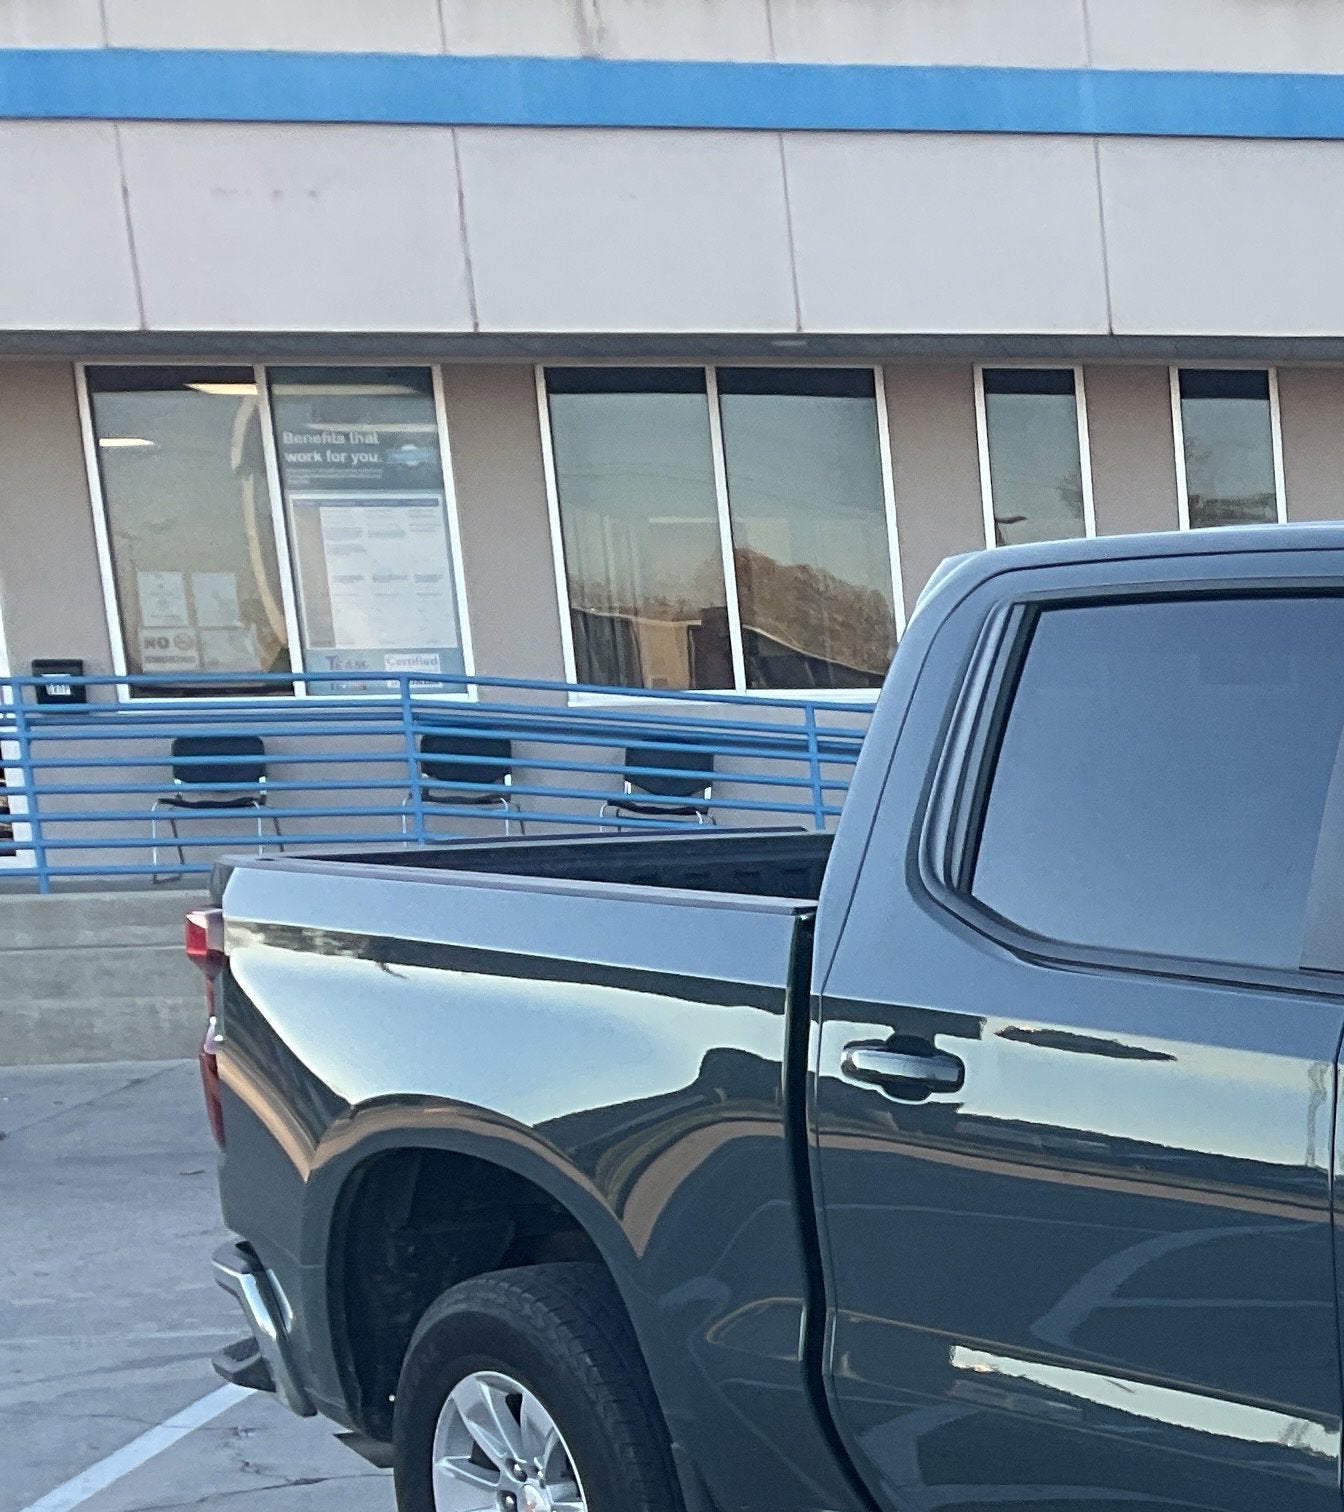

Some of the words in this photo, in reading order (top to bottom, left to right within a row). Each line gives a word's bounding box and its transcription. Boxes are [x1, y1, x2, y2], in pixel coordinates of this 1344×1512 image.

[283, 431, 345, 445] Benefits
[350, 431, 380, 445] that
[284, 450, 323, 463] work
[326, 449, 346, 463] for
[143, 636, 171, 650] NO
